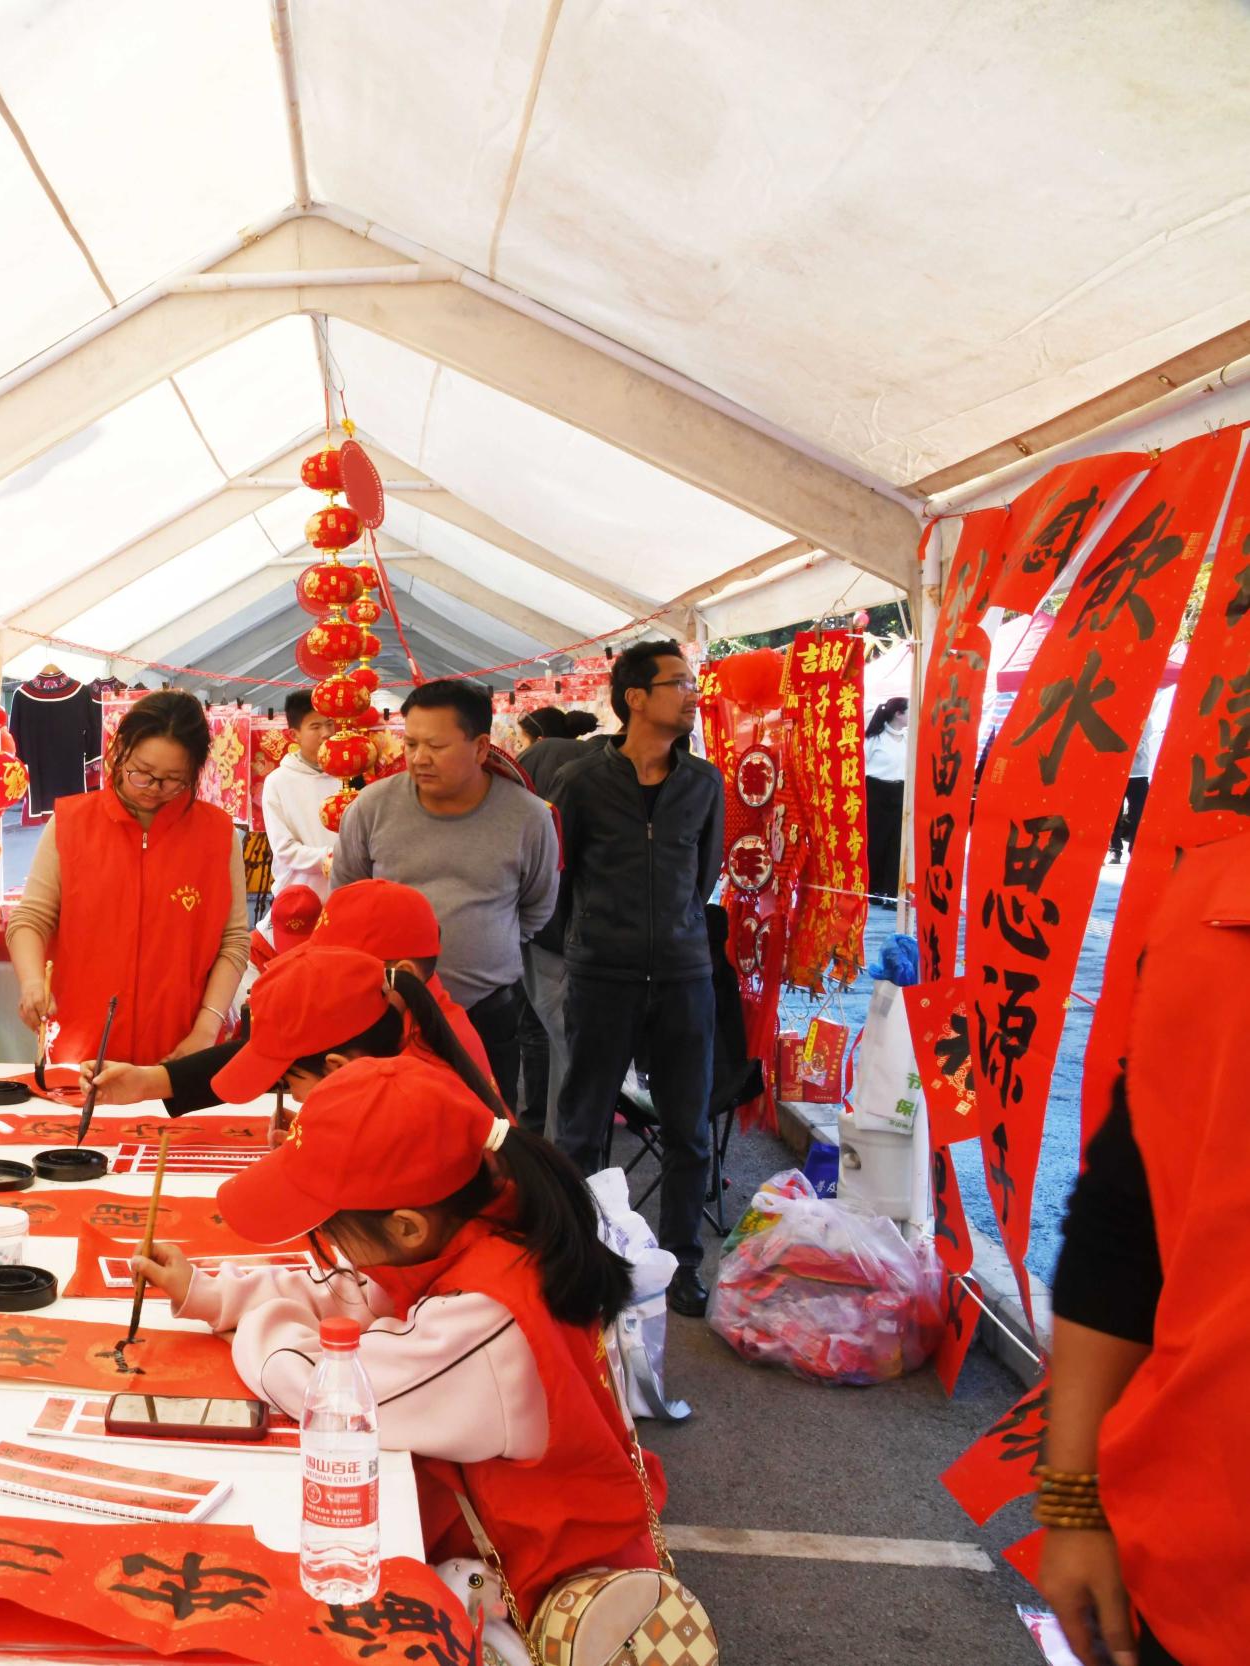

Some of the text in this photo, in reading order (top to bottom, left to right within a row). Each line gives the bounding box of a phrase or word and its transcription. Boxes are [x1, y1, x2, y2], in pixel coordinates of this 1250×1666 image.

[796, 640, 850, 674] 吉星高
[334, 1476, 362, 1484] CENTER
